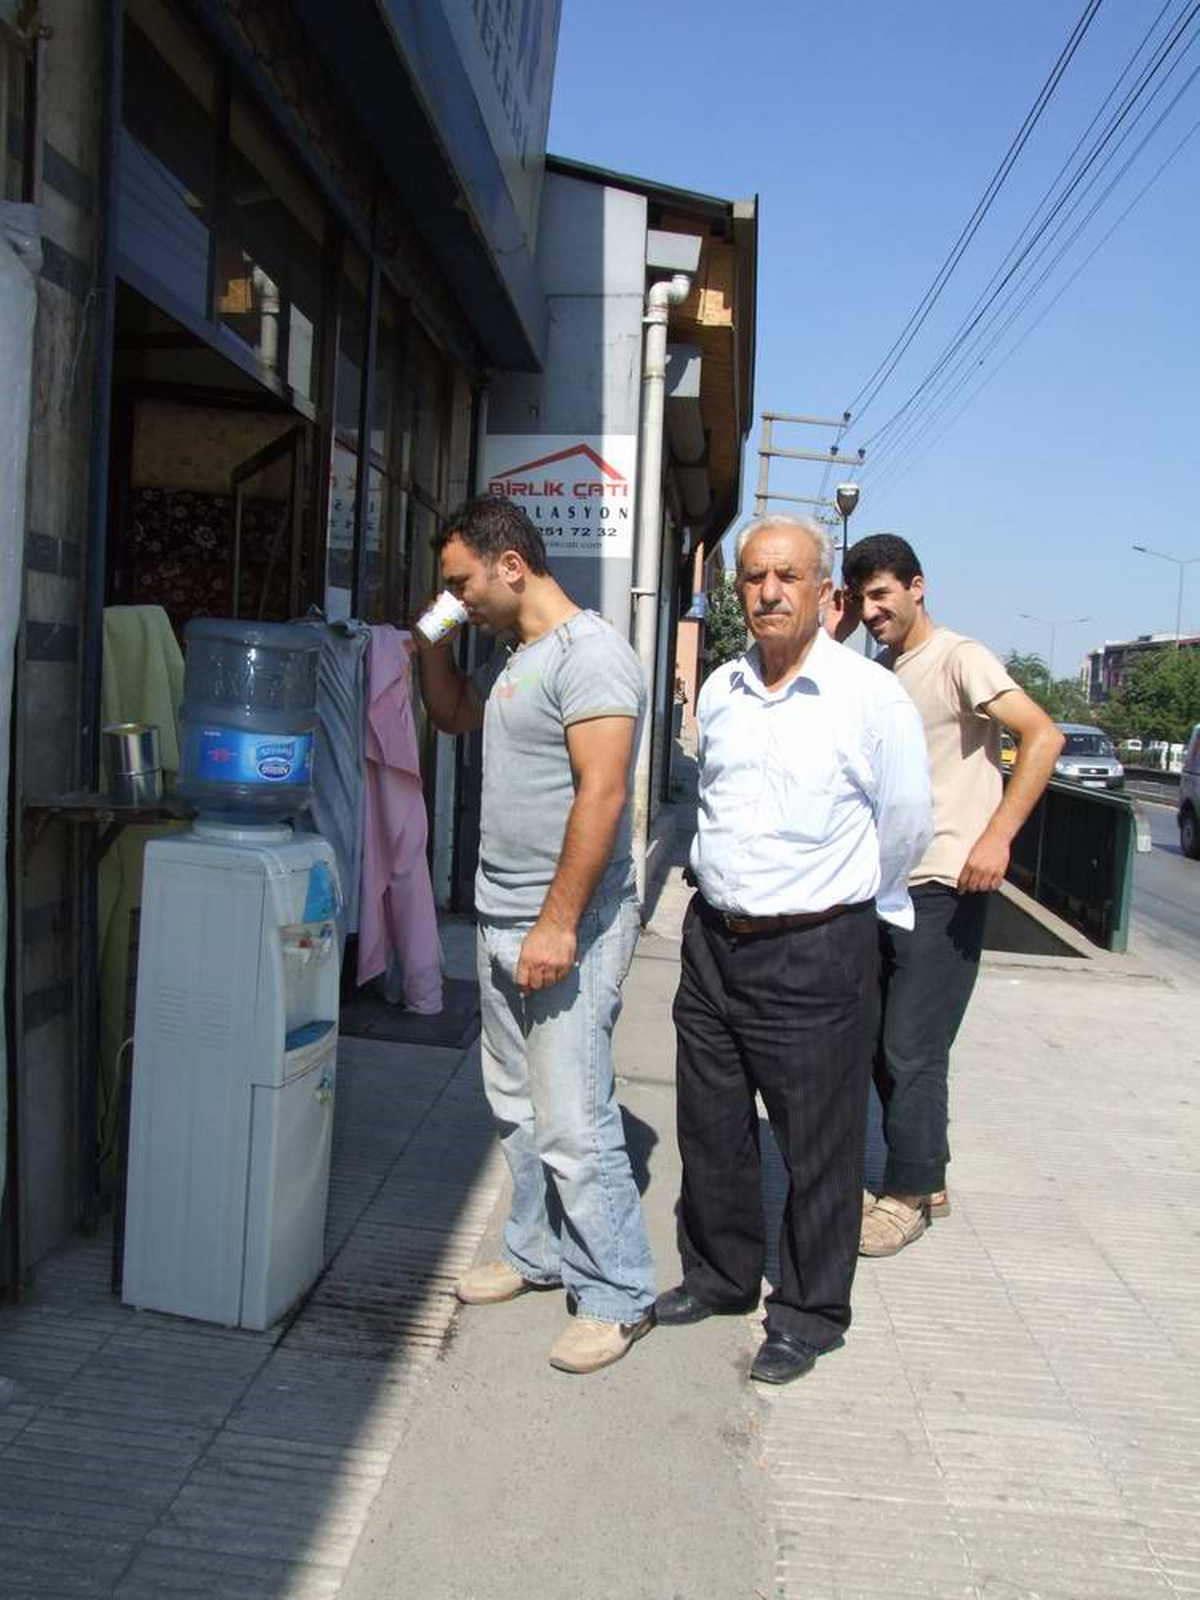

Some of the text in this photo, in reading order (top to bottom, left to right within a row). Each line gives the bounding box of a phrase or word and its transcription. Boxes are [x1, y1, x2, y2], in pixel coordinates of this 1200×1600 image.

[488, 480, 628, 499] BİRLİK ÇATI
[511, 504, 628, 519] OLASYON
[570, 526, 591, 537] 72
[597, 526, 618, 537] 32
